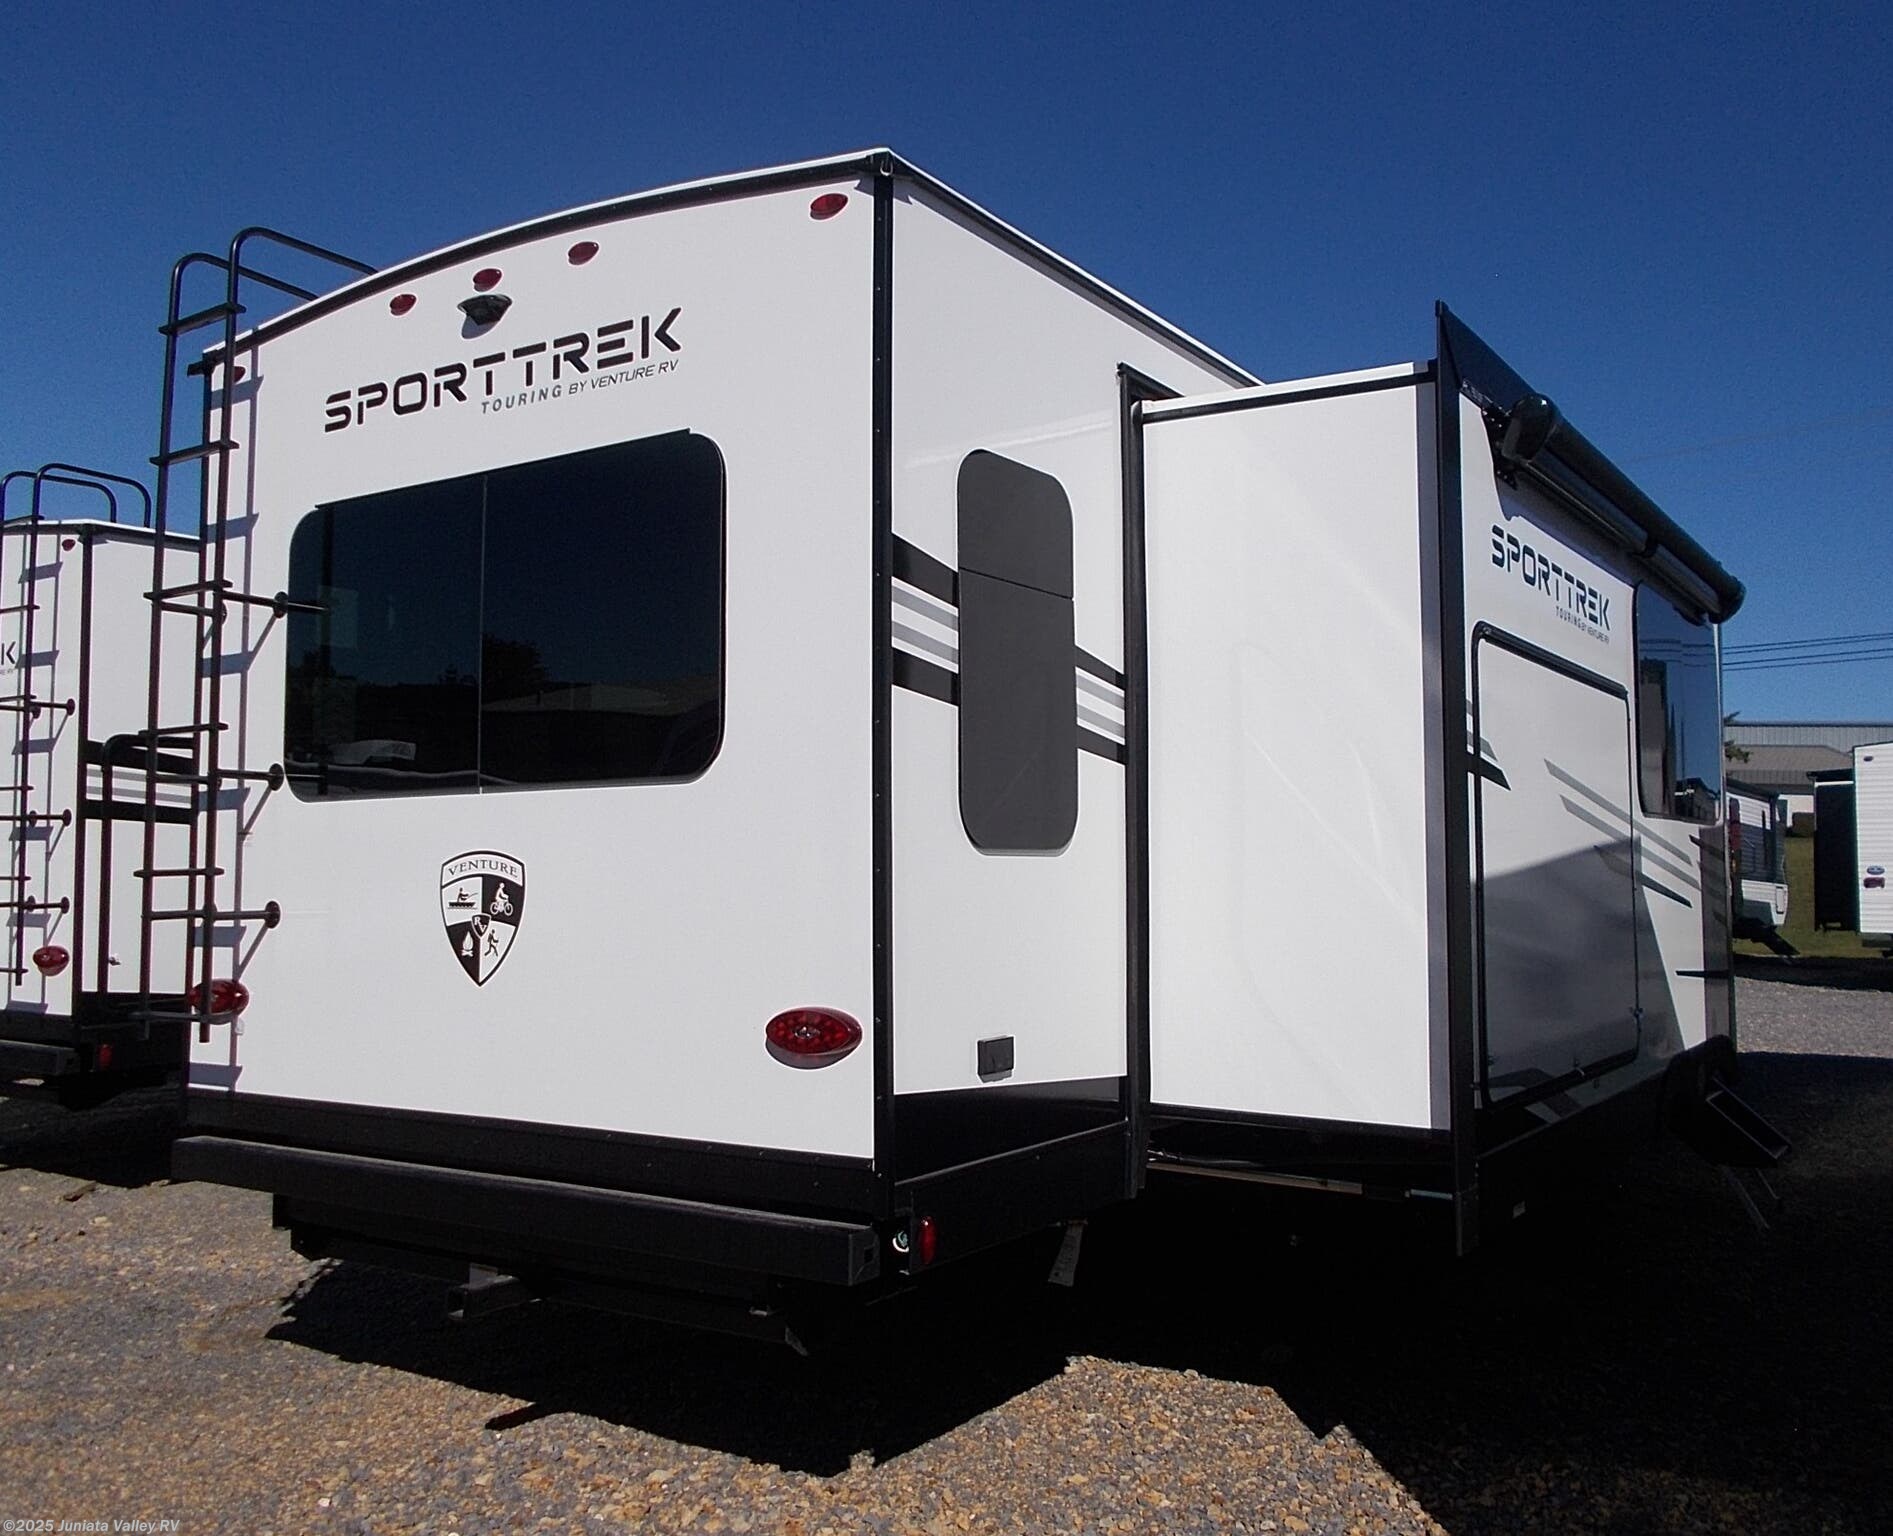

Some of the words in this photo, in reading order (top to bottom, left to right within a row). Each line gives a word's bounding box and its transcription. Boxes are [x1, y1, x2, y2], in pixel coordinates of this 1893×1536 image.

[325, 307, 682, 432] SPORTTREK
[481, 385, 562, 415] TOURING
[568, 379, 588, 395] BY
[591, 364, 656, 389] VENTURE
[658, 359, 679, 375] RV
[1492, 524, 1610, 631] SPORTTREK
[448, 859, 518, 878] VENTURE
